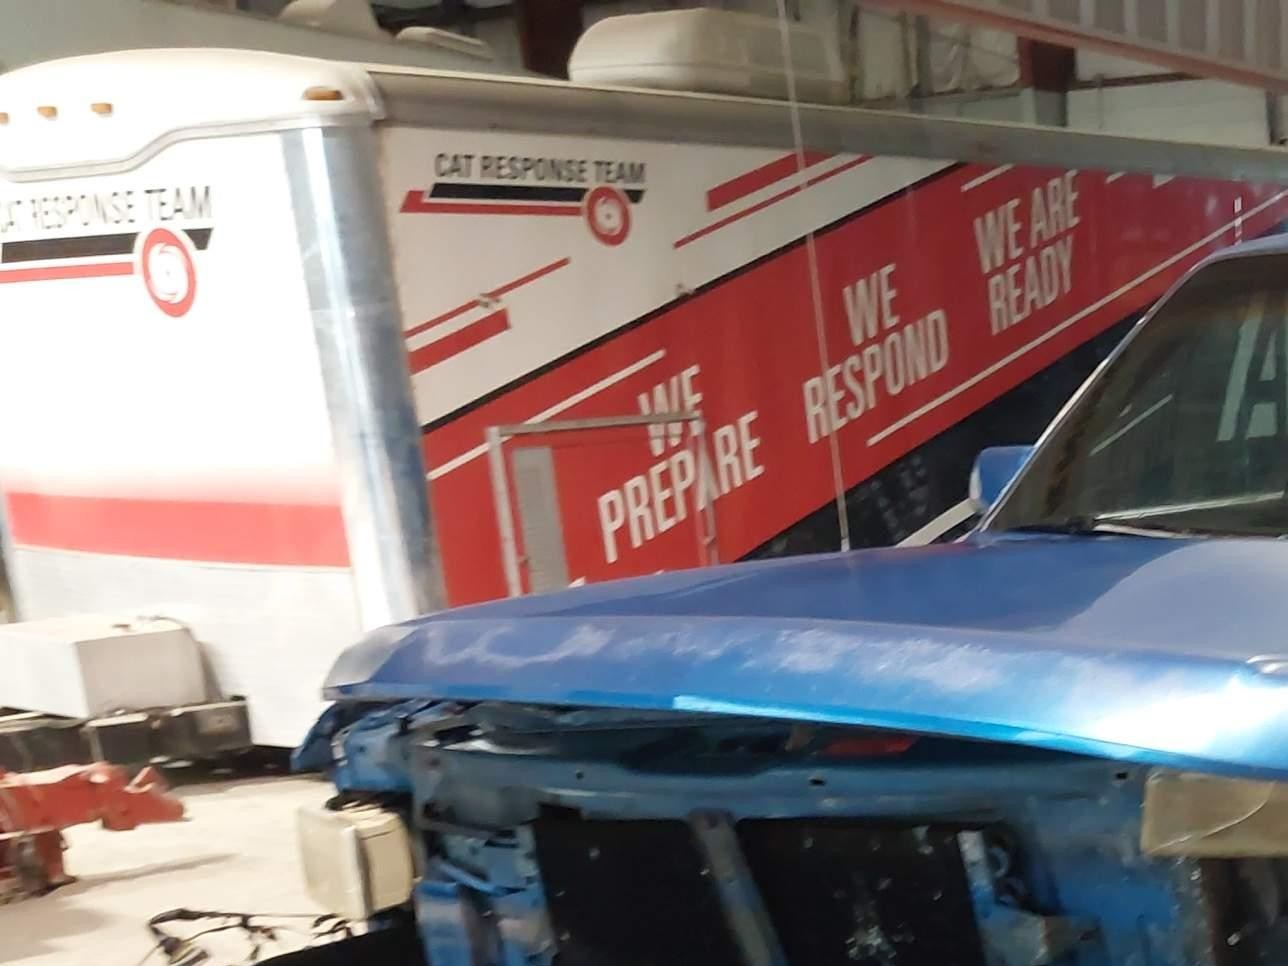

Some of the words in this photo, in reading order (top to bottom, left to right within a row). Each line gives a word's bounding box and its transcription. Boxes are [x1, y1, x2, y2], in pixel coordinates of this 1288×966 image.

[31, 191, 134, 230] RESPONSE
[144, 186, 211, 221] TEAM
[434, 153, 474, 177] CAT
[480, 155, 587, 182] RESPONSE
[595, 160, 647, 184] TEAM
[974, 198, 1023, 274] WE
[1030, 169, 1080, 249] ARE
[843, 263, 900, 346] WE
[988, 234, 1074, 336] READY
[637, 364, 704, 457] WE
[803, 309, 949, 444] RESPOND
[597, 410, 765, 564] PREPARE
